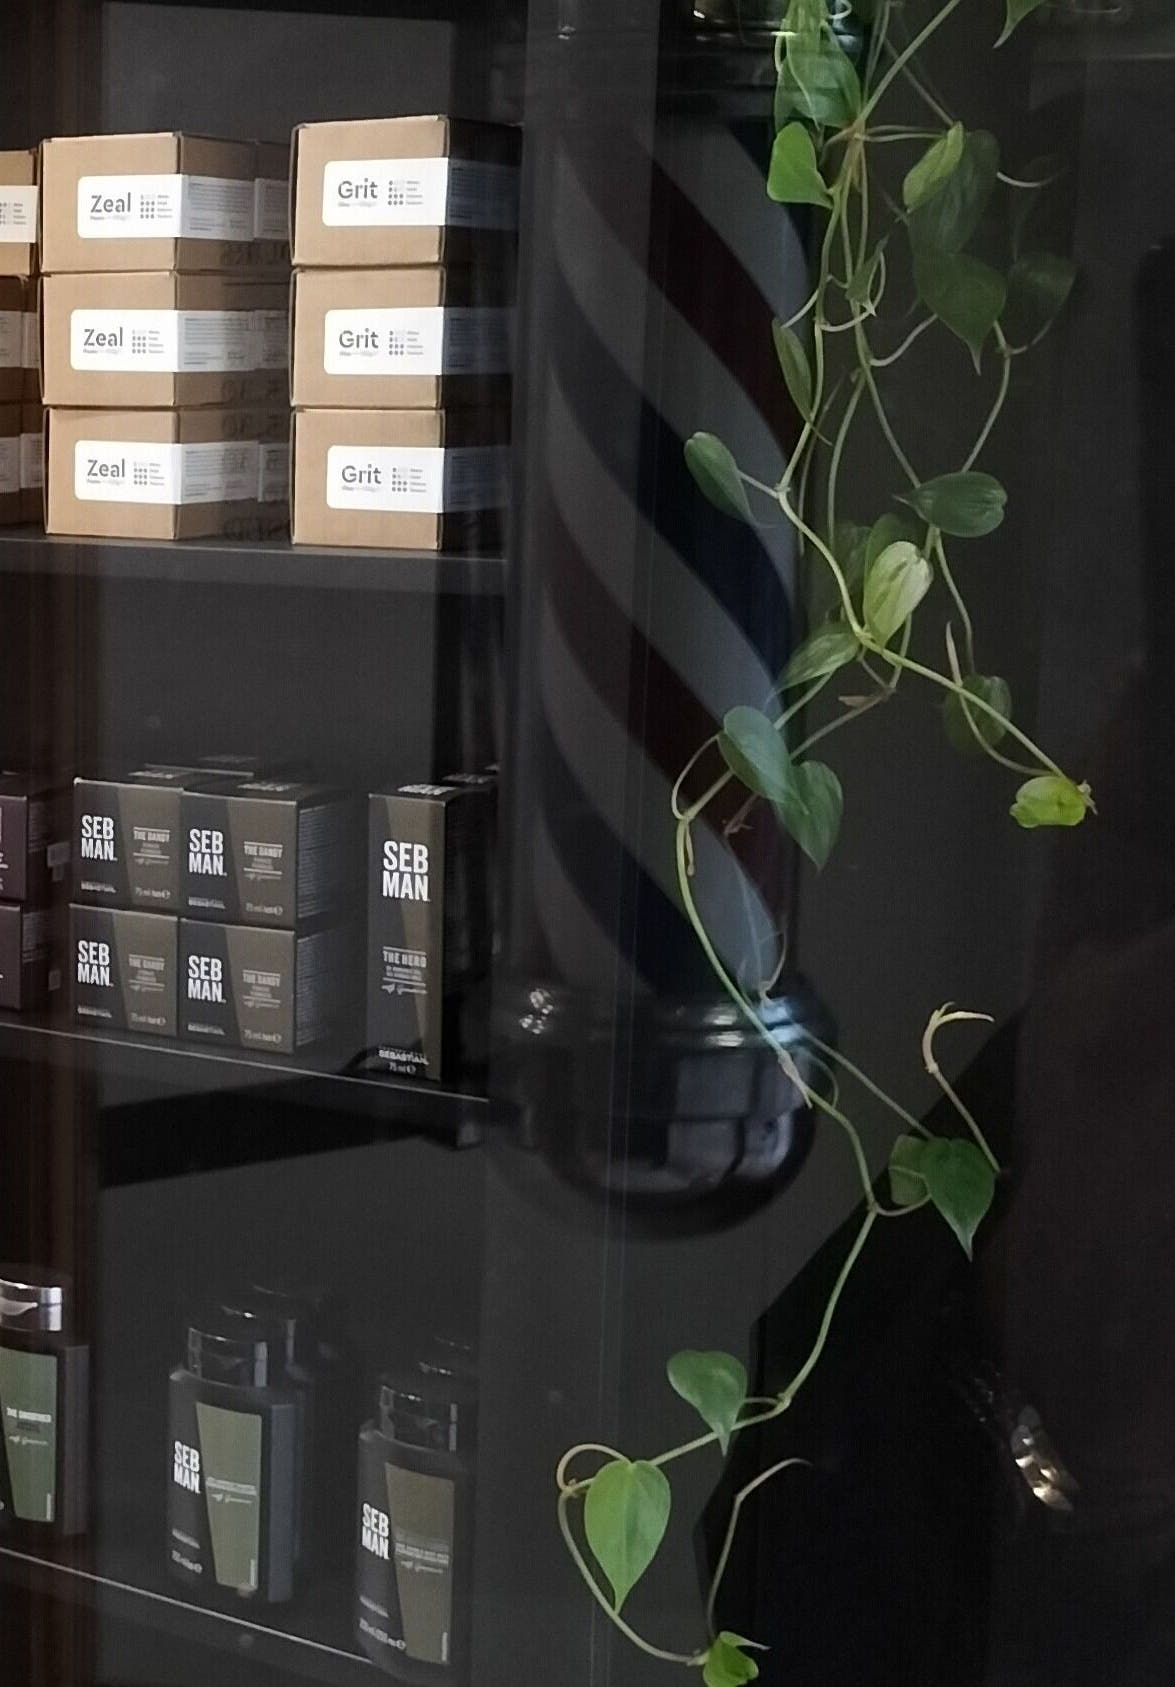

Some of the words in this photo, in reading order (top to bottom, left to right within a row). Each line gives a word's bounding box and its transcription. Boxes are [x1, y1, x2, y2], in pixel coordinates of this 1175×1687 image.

[337, 178, 379, 200] Grit
[90, 192, 132, 213] Zeal
[83, 327, 124, 348] Zeal
[338, 329, 380, 350] Grit
[87, 459, 126, 479] Zeal
[341, 464, 382, 486] Grit
[81, 814, 114, 840] SEB
[189, 828, 224, 854] SEB
[383, 840, 429, 874] SEB
[78, 940, 110, 966] SEB
[382, 950, 401, 965] THE
[188, 955, 222, 982] SEB
[173, 1440, 200, 1472] SEB
[362, 1502, 390, 1537] SEB
